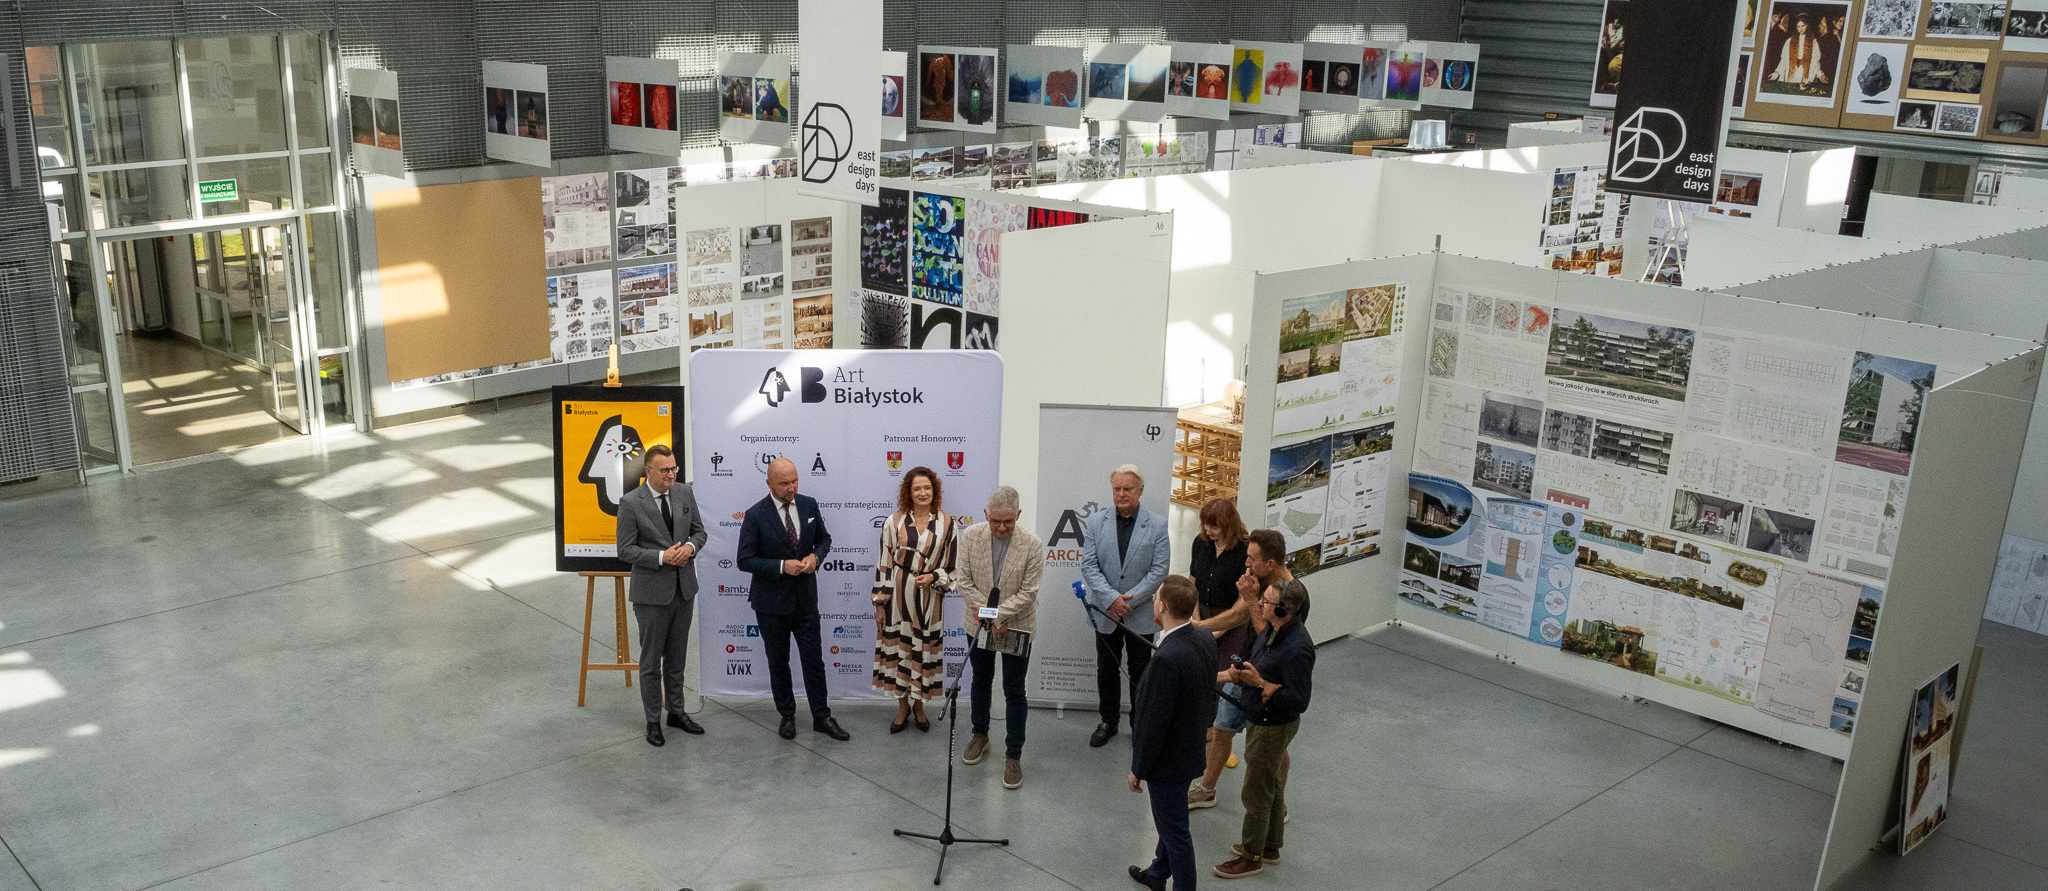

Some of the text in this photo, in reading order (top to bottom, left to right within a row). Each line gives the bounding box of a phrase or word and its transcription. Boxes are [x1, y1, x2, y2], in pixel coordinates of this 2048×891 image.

[857, 150, 876, 162] east
[1689, 152, 1714, 163] east
[847, 160, 876, 178] design
[1674, 162, 1712, 178] design
[201, 183, 234, 192] WYJŚCIE
[855, 179, 876, 194] days
[1683, 178, 1710, 192] days
[912, 229, 965, 259] OCEAN
[912, 284, 964, 307] POLLUTION
[833, 366, 865, 383] Art
[834, 387, 924, 408] Białystok
[1548, 379, 1565, 387] Nowa
[1564, 382, 1584, 391] jakość
[1584, 385, 1600, 394] życia
[1606, 390, 1627, 400] starych
[1627, 394, 1659, 405] strukturach
[740, 434, 800, 444] Organizatorzy:
[884, 434, 966, 445] Patronat Honorowy:
[817, 500, 893, 511] tnerzy strategiczni:
[1046, 549, 1083, 561] ARCH
[821, 559, 855, 572] olta
[819, 612, 877, 621] rtnerzy medial
[726, 663, 752, 676] LYNX
